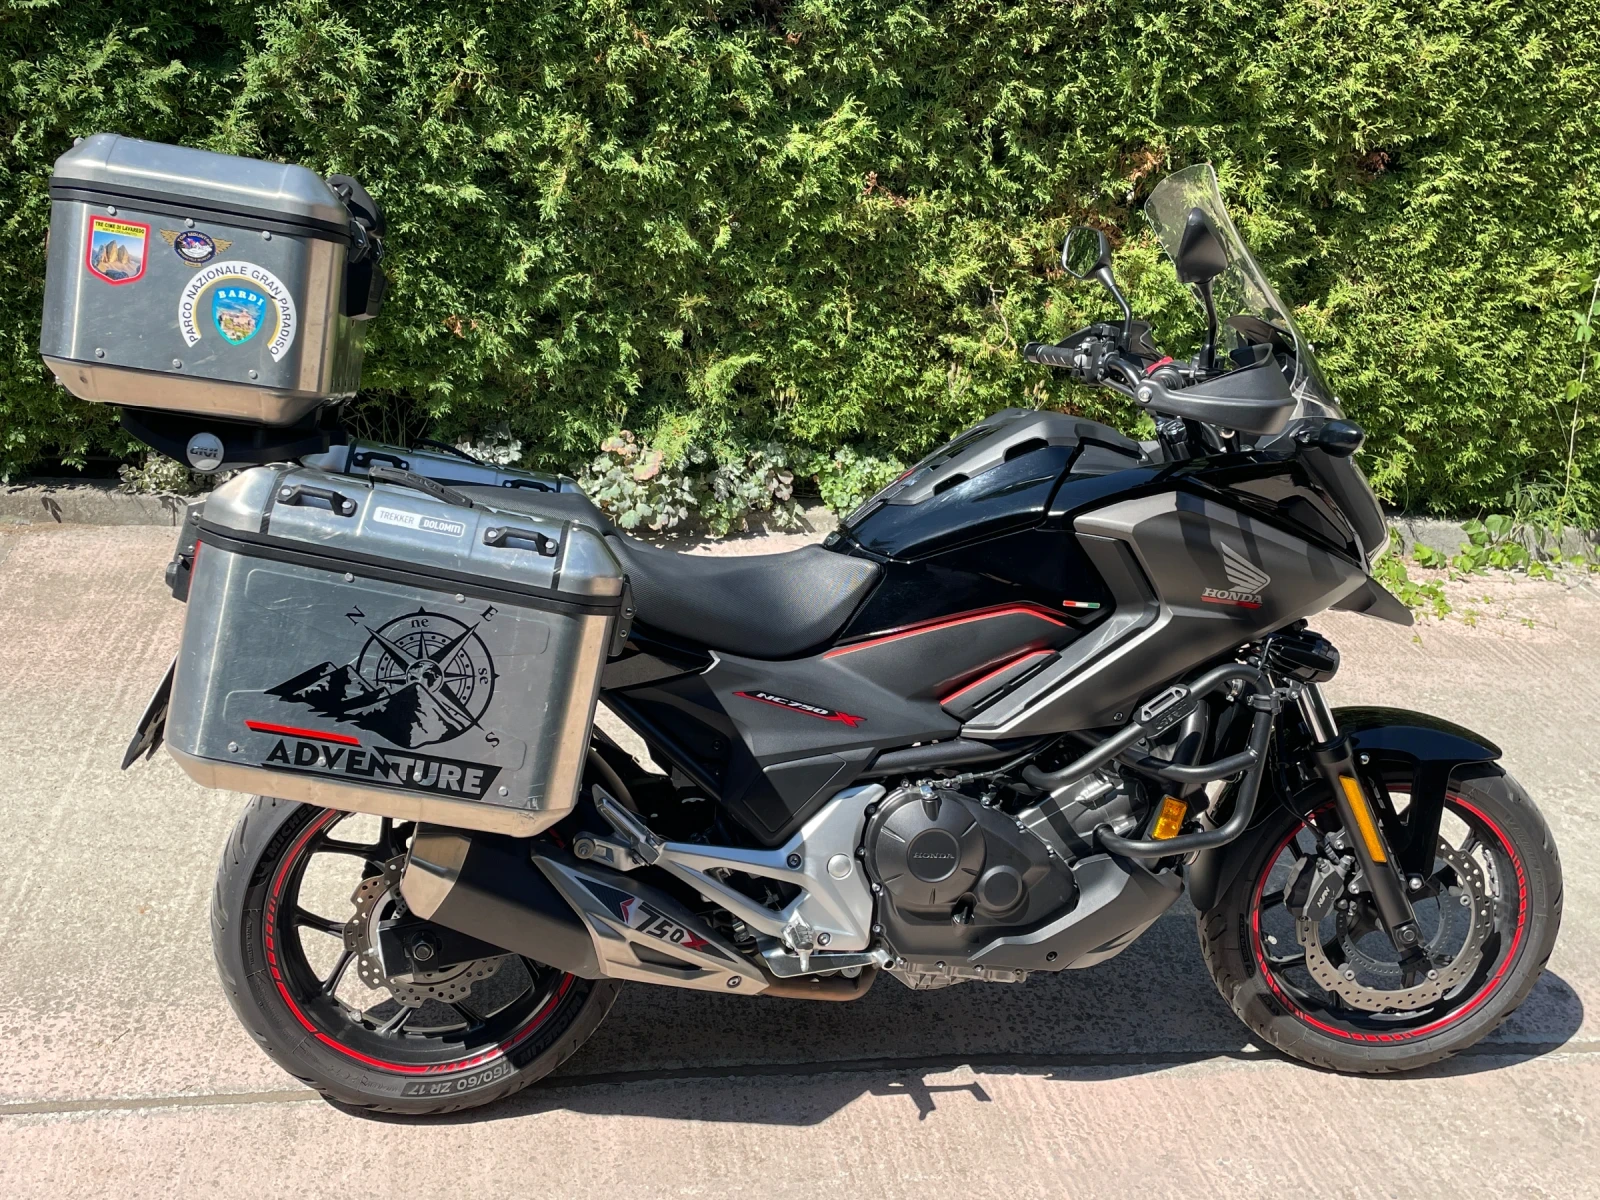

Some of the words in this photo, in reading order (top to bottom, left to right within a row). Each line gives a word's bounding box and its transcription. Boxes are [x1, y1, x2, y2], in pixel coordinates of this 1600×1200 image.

[122, 225, 145, 234] LAVAREDO
[177, 232, 187, 242] TOP
[187, 265, 248, 300] NAZIONALE
[251, 270, 282, 296] GRAN
[218, 290, 264, 306] BARDI
[182, 302, 199, 343] PARCO
[270, 297, 291, 355] PARADISO
[190, 446, 219, 458] GIVI
[379, 510, 415, 525] TREKKER
[1202, 587, 1263, 604] HONDA
[344, 605, 366, 626] N
[479, 604, 499, 622] E
[410, 618, 430, 628] ne
[484, 731, 500, 749] S
[265, 738, 485, 795] ADVENTURE
[520, 994, 583, 1065] MICHELIN
[456, 1061, 510, 1091] 160/60
[408, 1085, 429, 1096] 17
[430, 1081, 452, 1095] ZR
